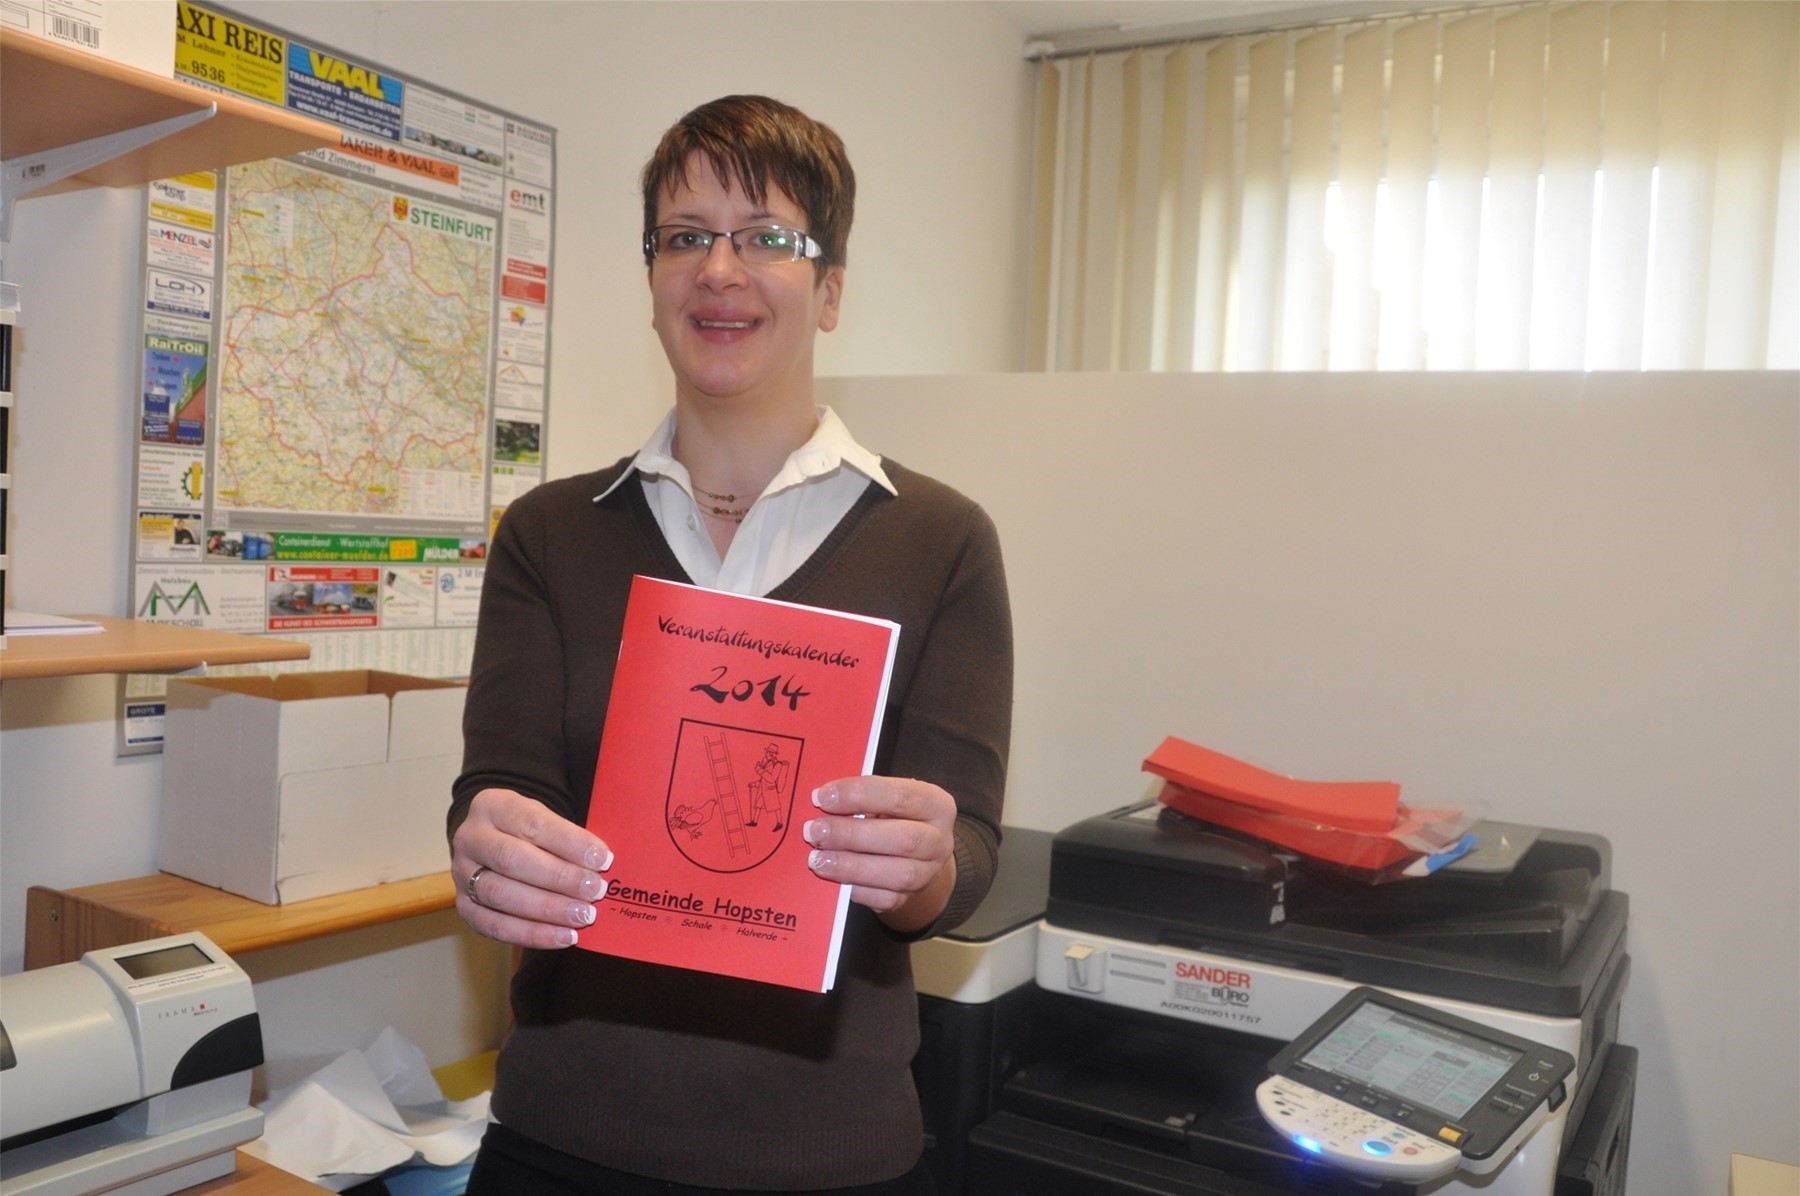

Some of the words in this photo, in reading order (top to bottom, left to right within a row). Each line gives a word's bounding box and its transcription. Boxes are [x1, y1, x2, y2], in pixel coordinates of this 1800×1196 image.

[192, 38, 226, 58] Lehner
[224, 21, 282, 64] REIS
[289, 70, 342, 96] TRANSPORTE
[309, 51, 385, 100] VAAL
[296, 101, 393, 139] www.vaal-transporte.de
[328, 151, 377, 175] Zimmerei
[387, 148, 397, 163] &
[400, 153, 436, 175] VAAL
[510, 189, 545, 208] emt
[160, 229, 198, 246] MENZEL
[410, 207, 494, 242] STEINFURT
[149, 336, 204, 356] RaiTrOil
[279, 535, 331, 547] Containerdienst
[339, 537, 389, 549] Wertstoffhof
[423, 546, 460, 562] MÜLDER
[658, 615, 860, 668] Veranstaltungskalender
[690, 665, 811, 711] 2014
[606, 878, 704, 912] Gemeinde
[713, 896, 797, 928] Hopsten
[619, 907, 657, 922] Hopsten
[681, 918, 713, 931] Schale
[736, 926, 778, 942] Halverde
[1175, 962, 1251, 989] SANDER
[158, 1006, 195, 1019] FRAMA
